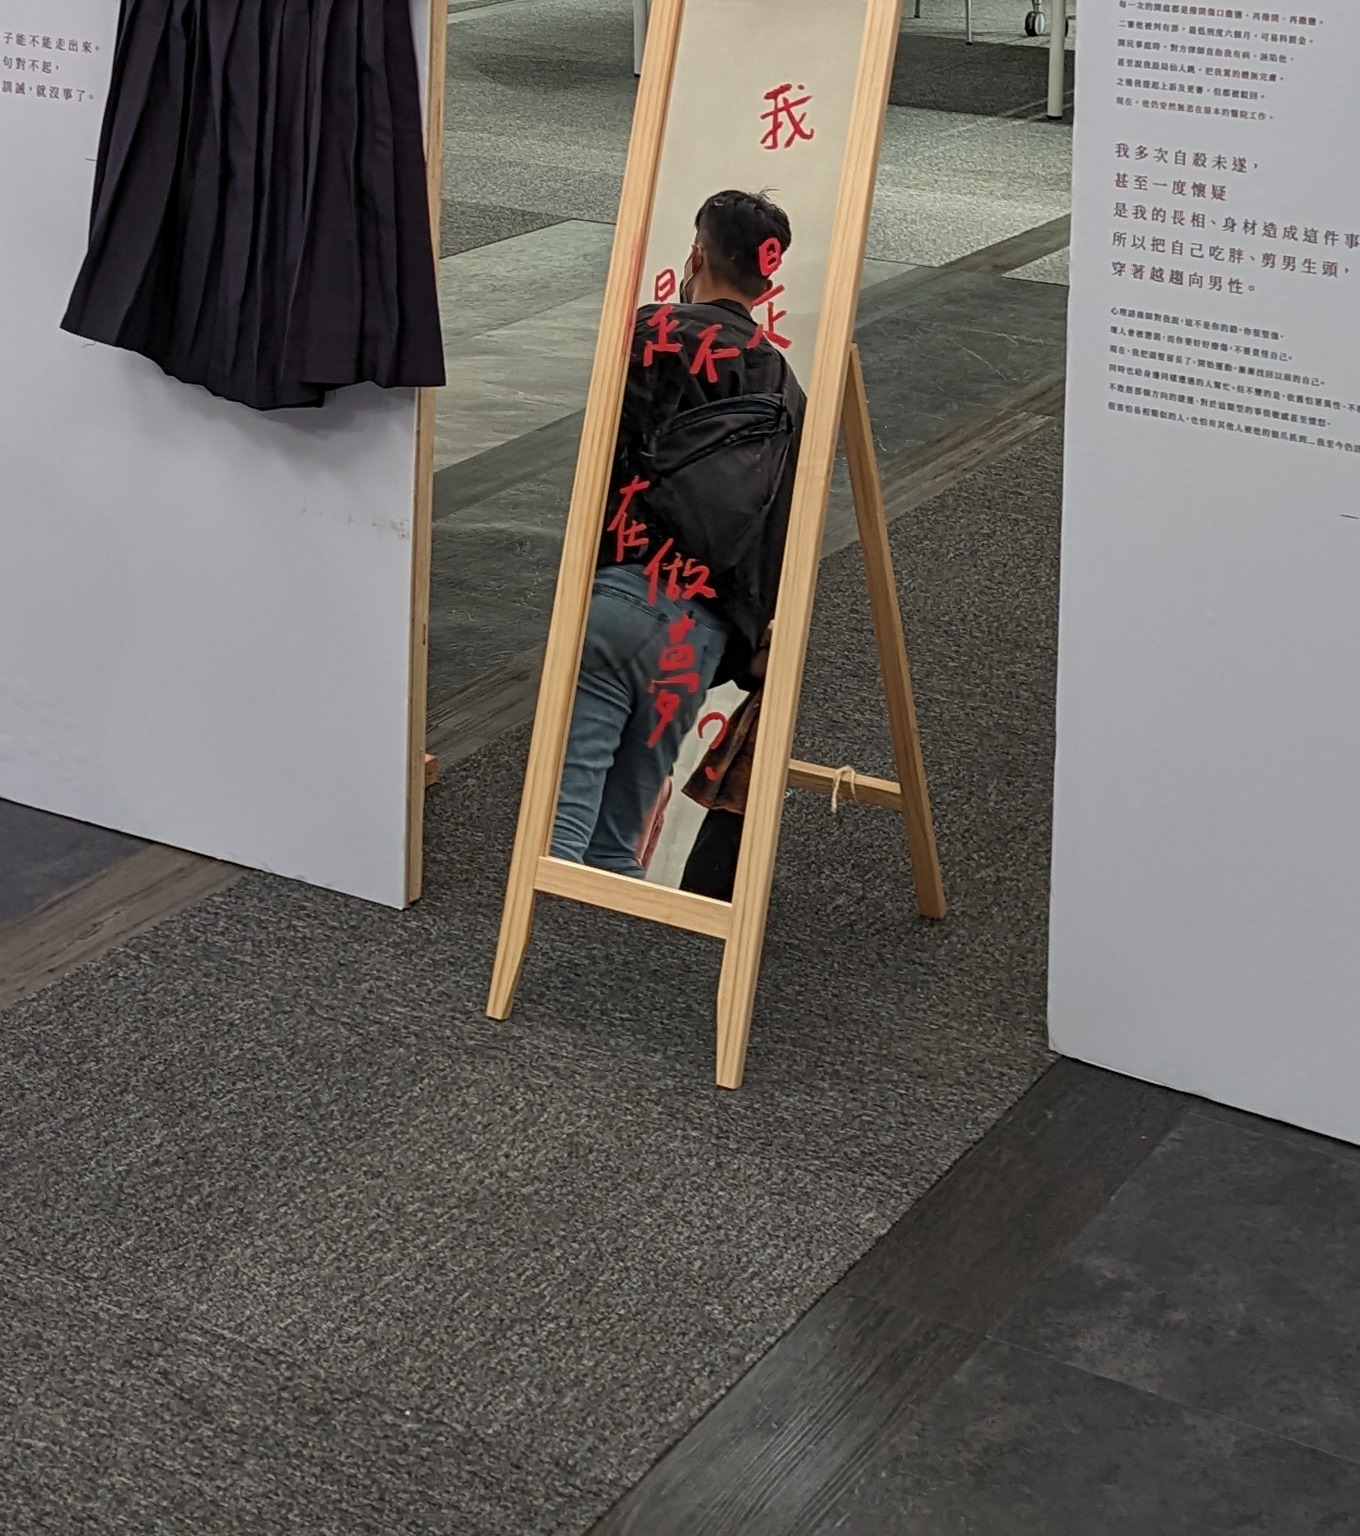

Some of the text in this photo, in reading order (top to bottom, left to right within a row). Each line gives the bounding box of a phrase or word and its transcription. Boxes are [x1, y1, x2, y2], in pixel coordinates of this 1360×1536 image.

[759, 82, 815, 151] 我
[1114, 143, 1259, 174] 我多次自殺未遂，
[1113, 173, 1228, 201] 甚至一度懷疑
[1111, 232, 1351, 279] 所以把自己吃胖、剪男生頭，
